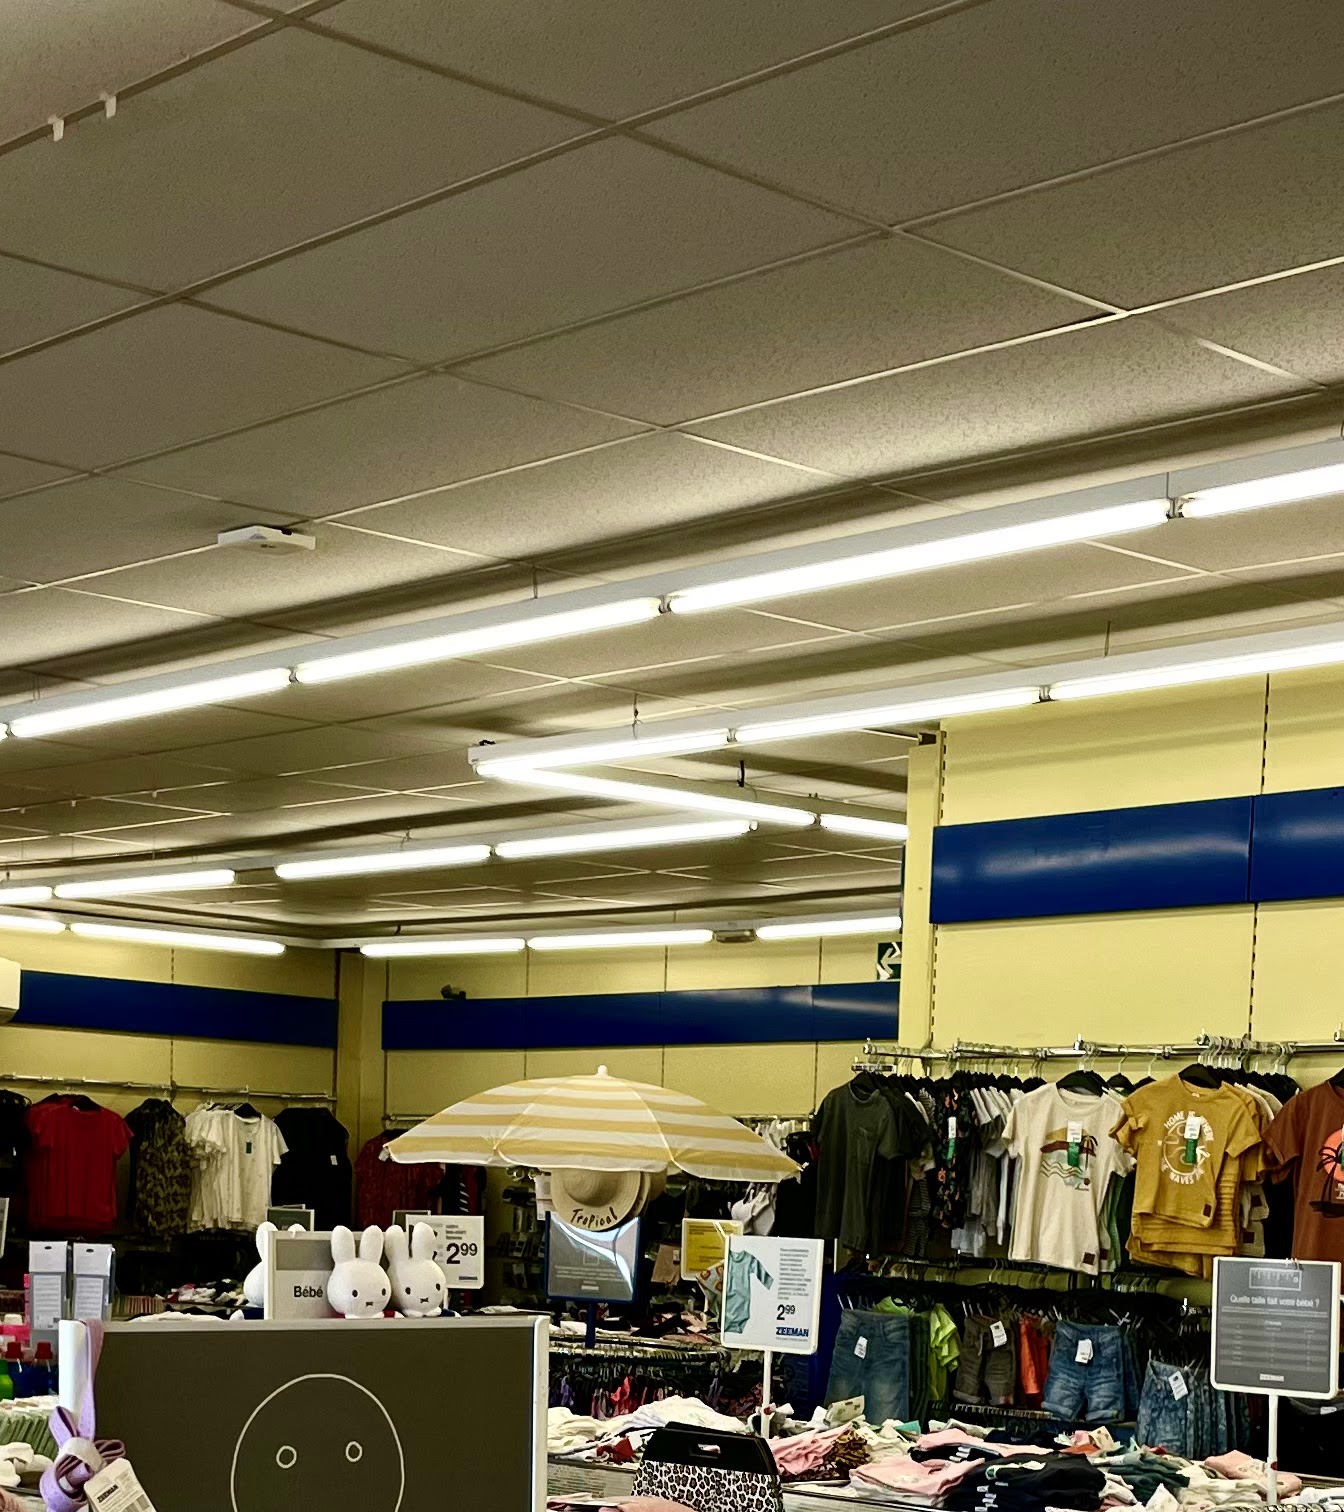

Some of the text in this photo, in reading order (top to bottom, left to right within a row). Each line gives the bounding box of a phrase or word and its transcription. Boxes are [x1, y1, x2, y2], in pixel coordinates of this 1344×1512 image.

[570, 1206, 619, 1227] Tropical
[447, 1243, 477, 1264] 299
[293, 1285, 323, 1298] Bébé
[776, 1327, 809, 1337] ZEEMAN
